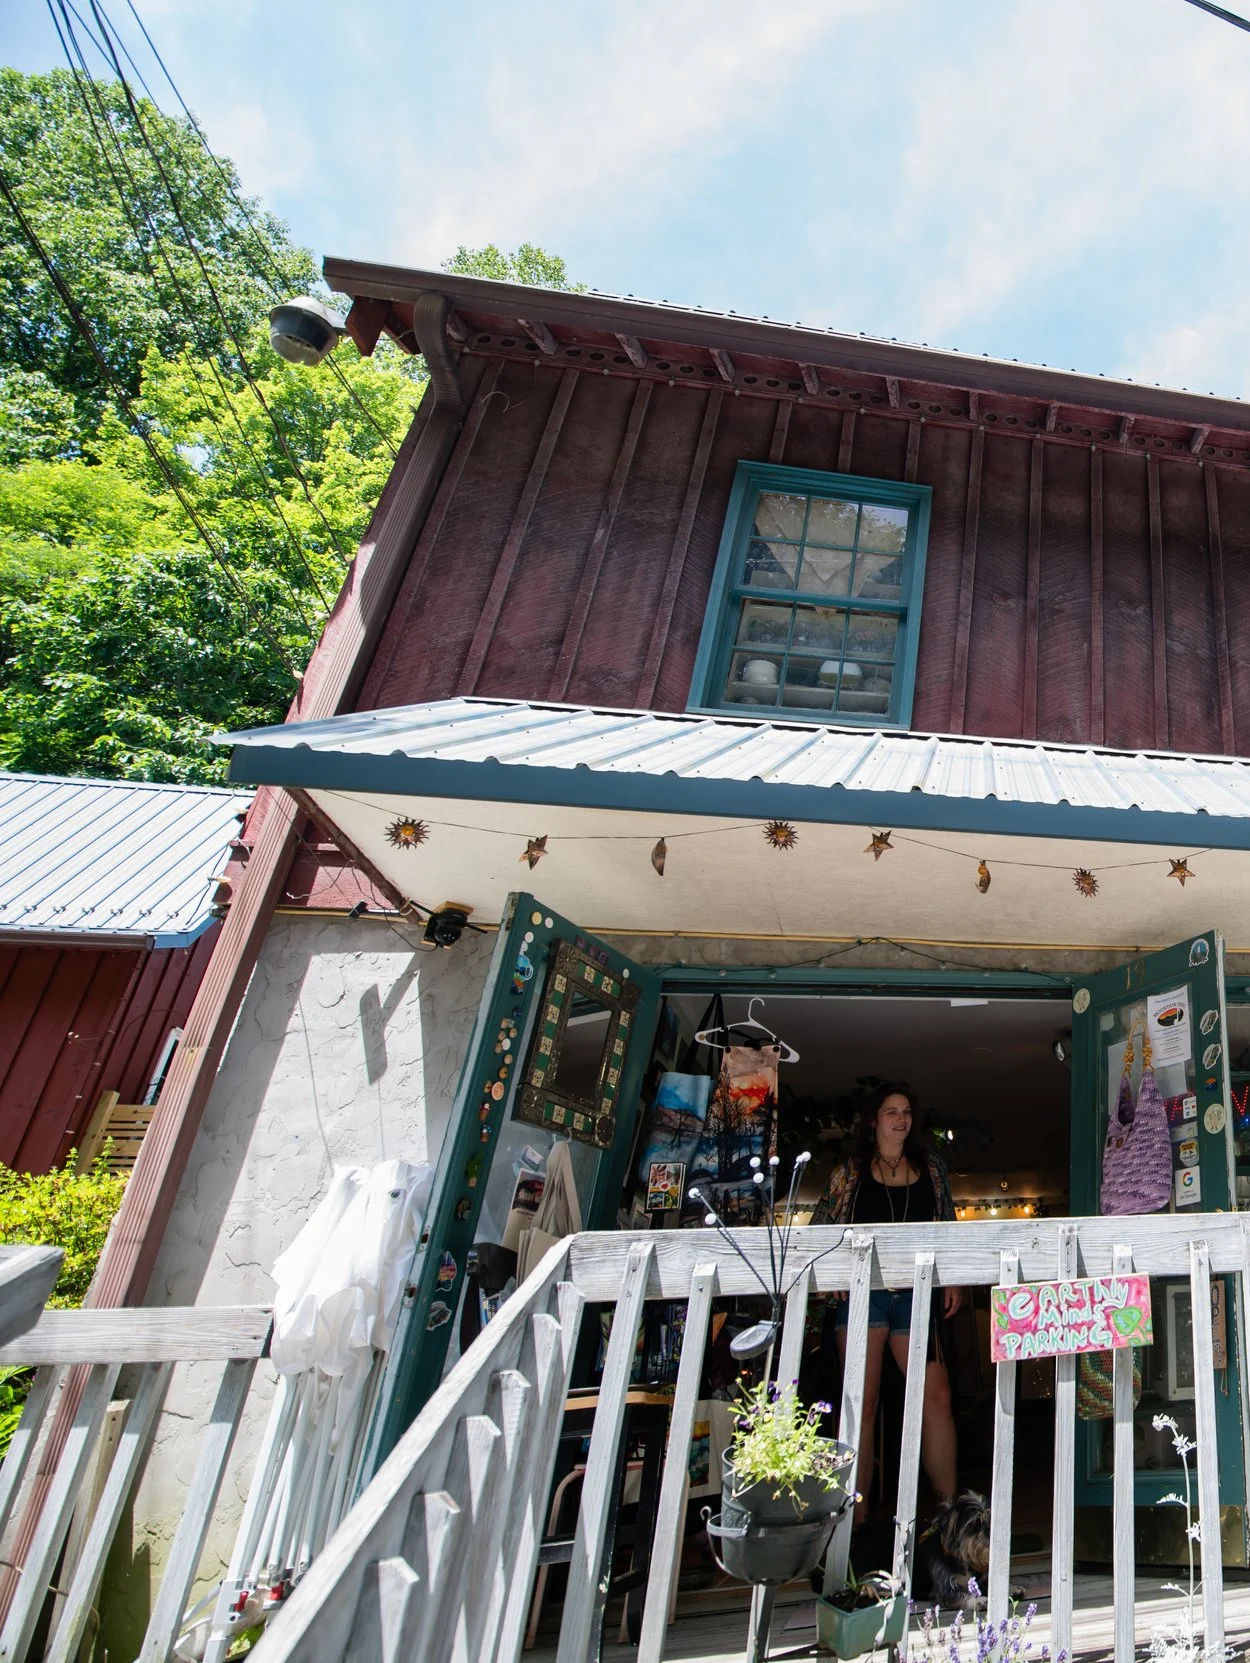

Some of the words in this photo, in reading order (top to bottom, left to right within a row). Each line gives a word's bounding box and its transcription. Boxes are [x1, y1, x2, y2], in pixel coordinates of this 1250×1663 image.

[1008, 1278, 1129, 1320] eARThly
[1038, 1303, 1106, 1329] Minds
[1001, 1322, 1113, 1359] PARKING
